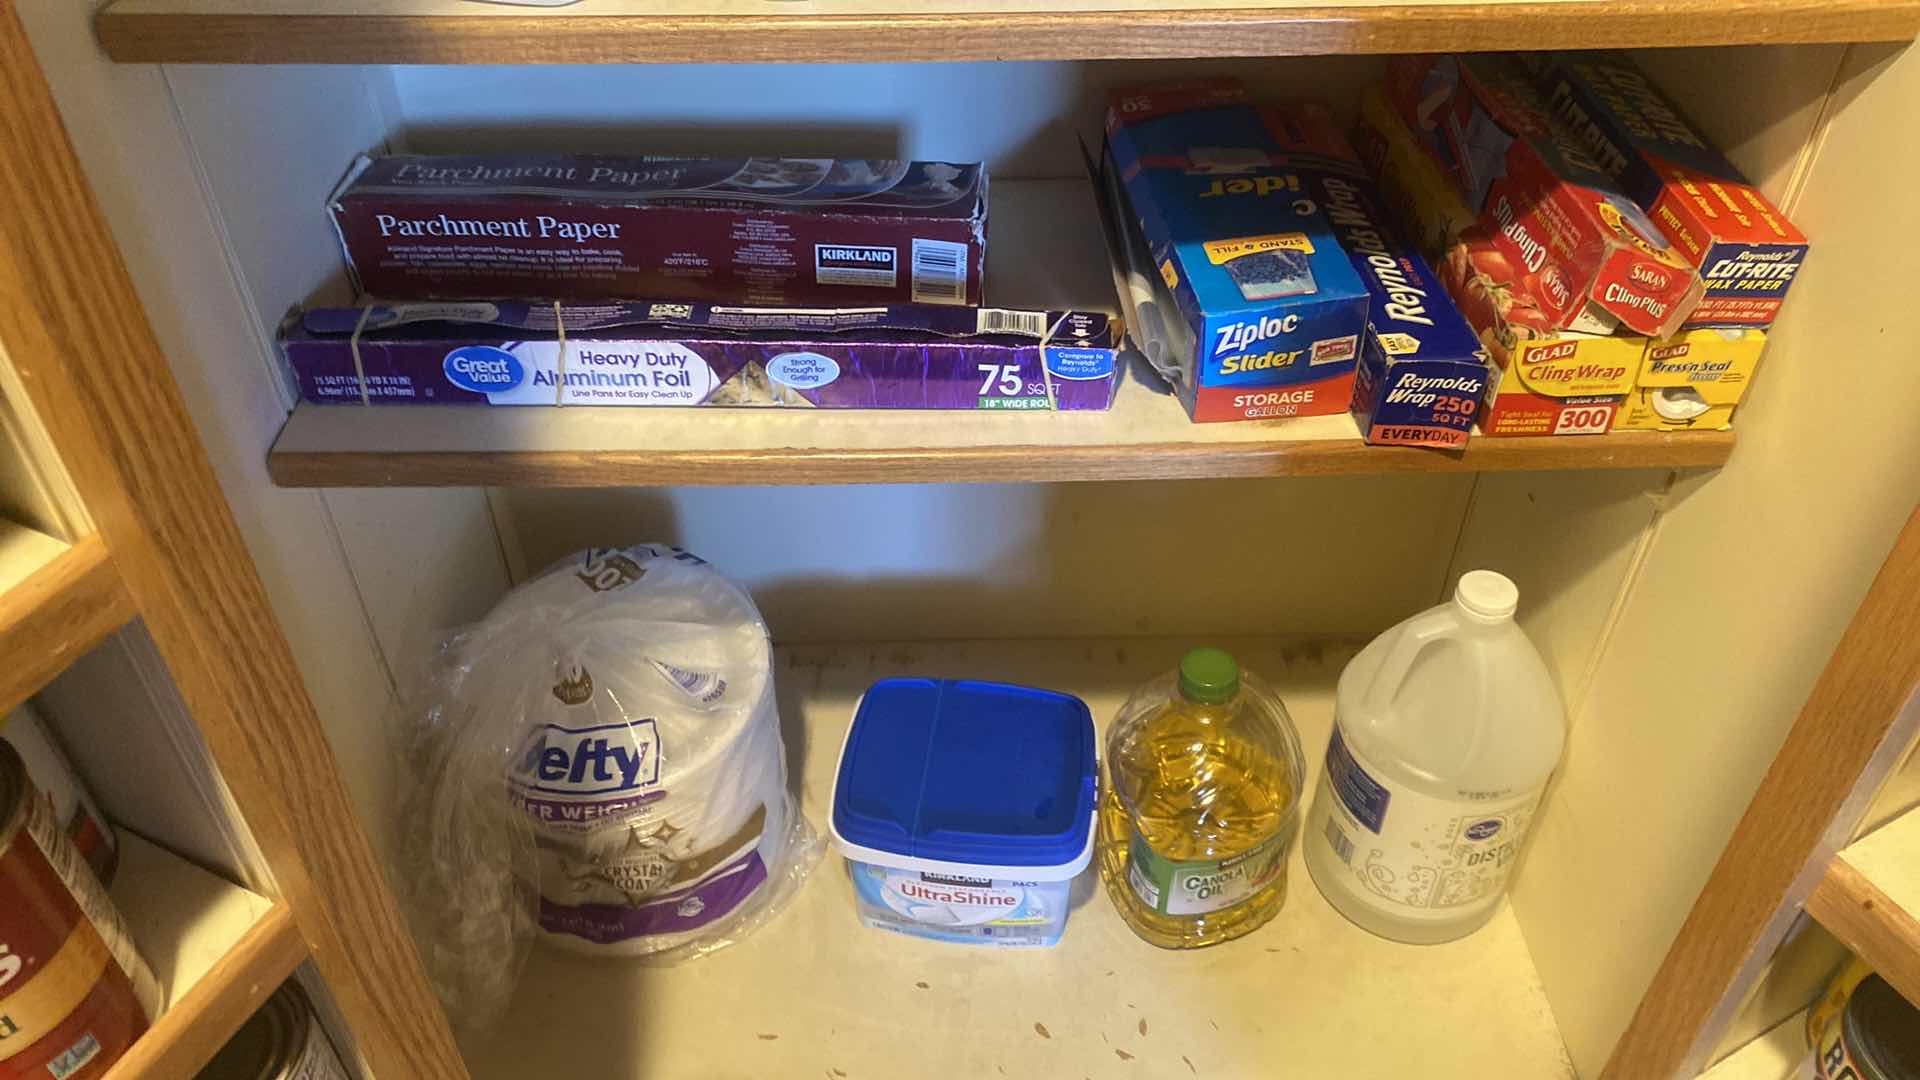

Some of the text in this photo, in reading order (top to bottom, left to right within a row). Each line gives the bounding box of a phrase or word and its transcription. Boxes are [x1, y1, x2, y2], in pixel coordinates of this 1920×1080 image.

[398, 163, 577, 182] Parchment
[588, 166, 690, 187] Paper
[1200, 175, 1302, 199] ider
[376, 214, 621, 243] Parchment Paper
[1213, 244, 1240, 254] FILL
[1259, 237, 1304, 250] STAND
[822, 249, 892, 263] KIRKLAND
[1631, 263, 1669, 289] SARAN
[1706, 259, 1800, 280] CUT-RITE
[1704, 280, 1784, 290] WAX PAPER
[1214, 314, 1299, 355] Ziploc
[579, 351, 688, 369] Heavy Duty
[1095, 352, 1105, 360] to
[1527, 345, 1576, 363] GLAD
[1653, 345, 1688, 359] GLAD
[453, 356, 509, 374] Great
[783, 366, 814, 374] Enough
[791, 359, 817, 367] Strong
[1219, 350, 1302, 376] Slider
[1701, 360, 1732, 372] Seal
[469, 372, 513, 384] Value
[533, 369, 691, 387] Aluminum Foil
[977, 364, 1023, 396] 75
[1027, 384, 1046, 396] SQ
[1529, 365, 1627, 383] Cling Wrap
[1396, 372, 1483, 395] Reynolds
[572, 389, 693, 400] Line Pans for Easy Clean Up
[1003, 399, 1029, 408] WIDE
[1030, 400, 1053, 408] ROL
[1233, 390, 1315, 409] STORAGE
[1385, 387, 1437, 408] Wrap
[1566, 396, 1592, 405] Value
[1244, 404, 1297, 418] GALLON
[1434, 396, 1476, 416] 250
[1431, 413, 1471, 427] SQ FT
[1559, 410, 1608, 429] 300
[1380, 427, 1462, 445] EVERYDAY
[1185, 867, 1245, 891] CANOLA
[901, 883, 1017, 906] UltraShine
[1196, 885, 1224, 900] OIL
